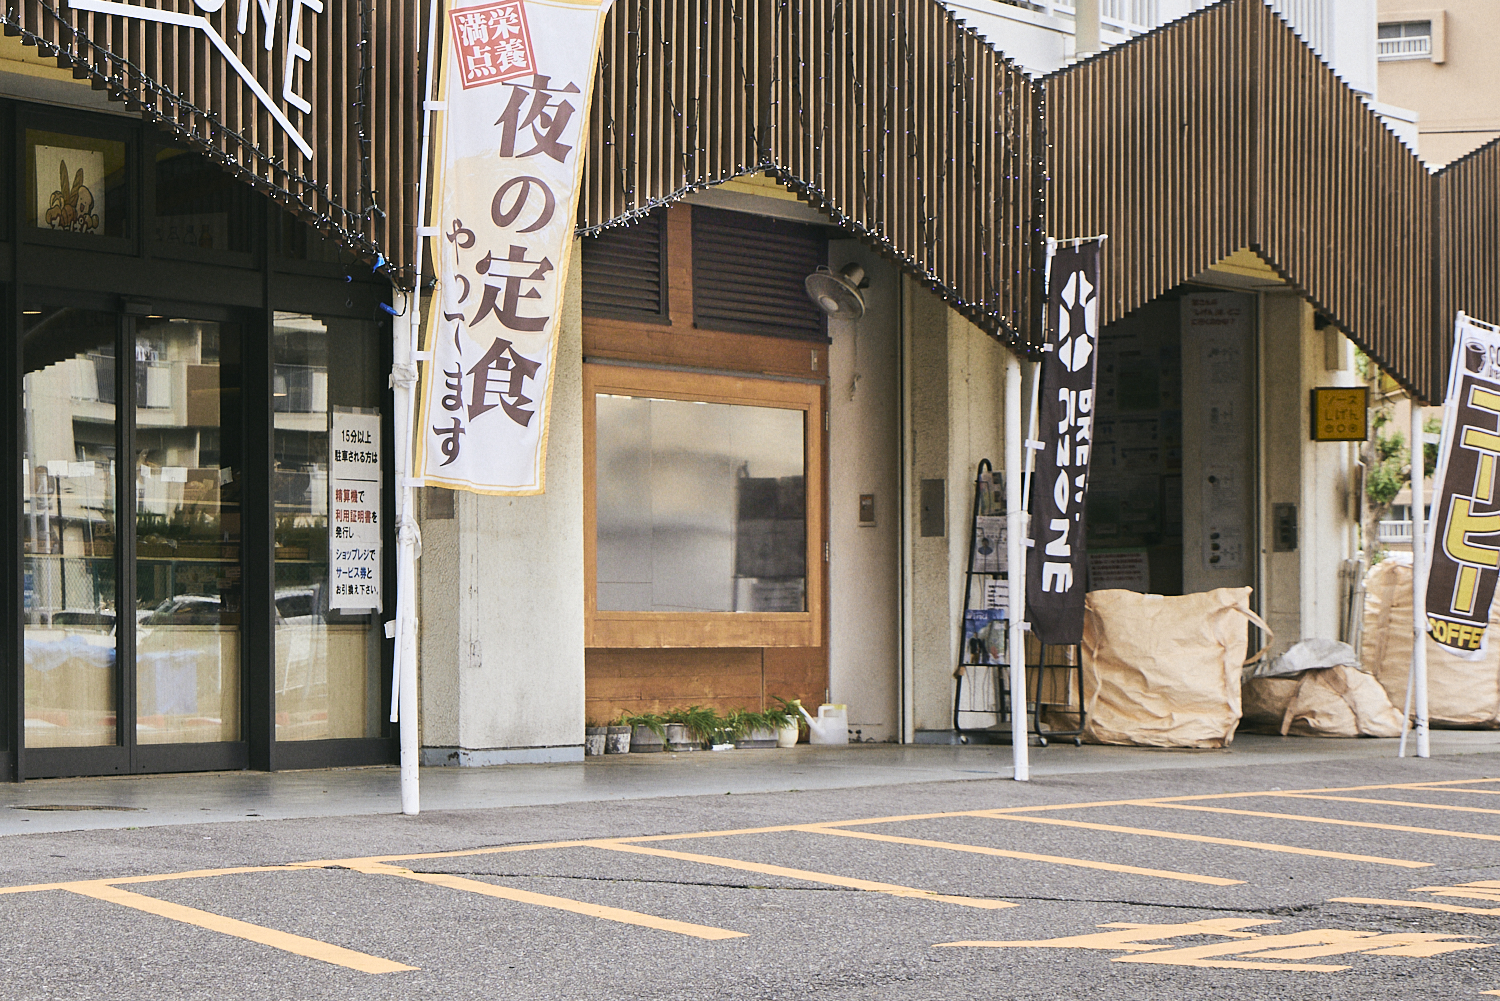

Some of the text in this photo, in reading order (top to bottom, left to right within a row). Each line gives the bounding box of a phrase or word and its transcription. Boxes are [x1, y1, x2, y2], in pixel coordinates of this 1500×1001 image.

[466, 74, 581, 427] 夜の定食
[432, 218, 477, 466] やってます
[341, 429, 372, 444] 15分以上
[334, 450, 378, 464] 駐車される方は
[335, 488, 365, 504] 精算機で
[335, 509, 378, 524] 利用証明書を
[335, 526, 354, 539] 発行し
[335, 548, 376, 562] ショップレジで
[335, 567, 373, 580] サービス券と
